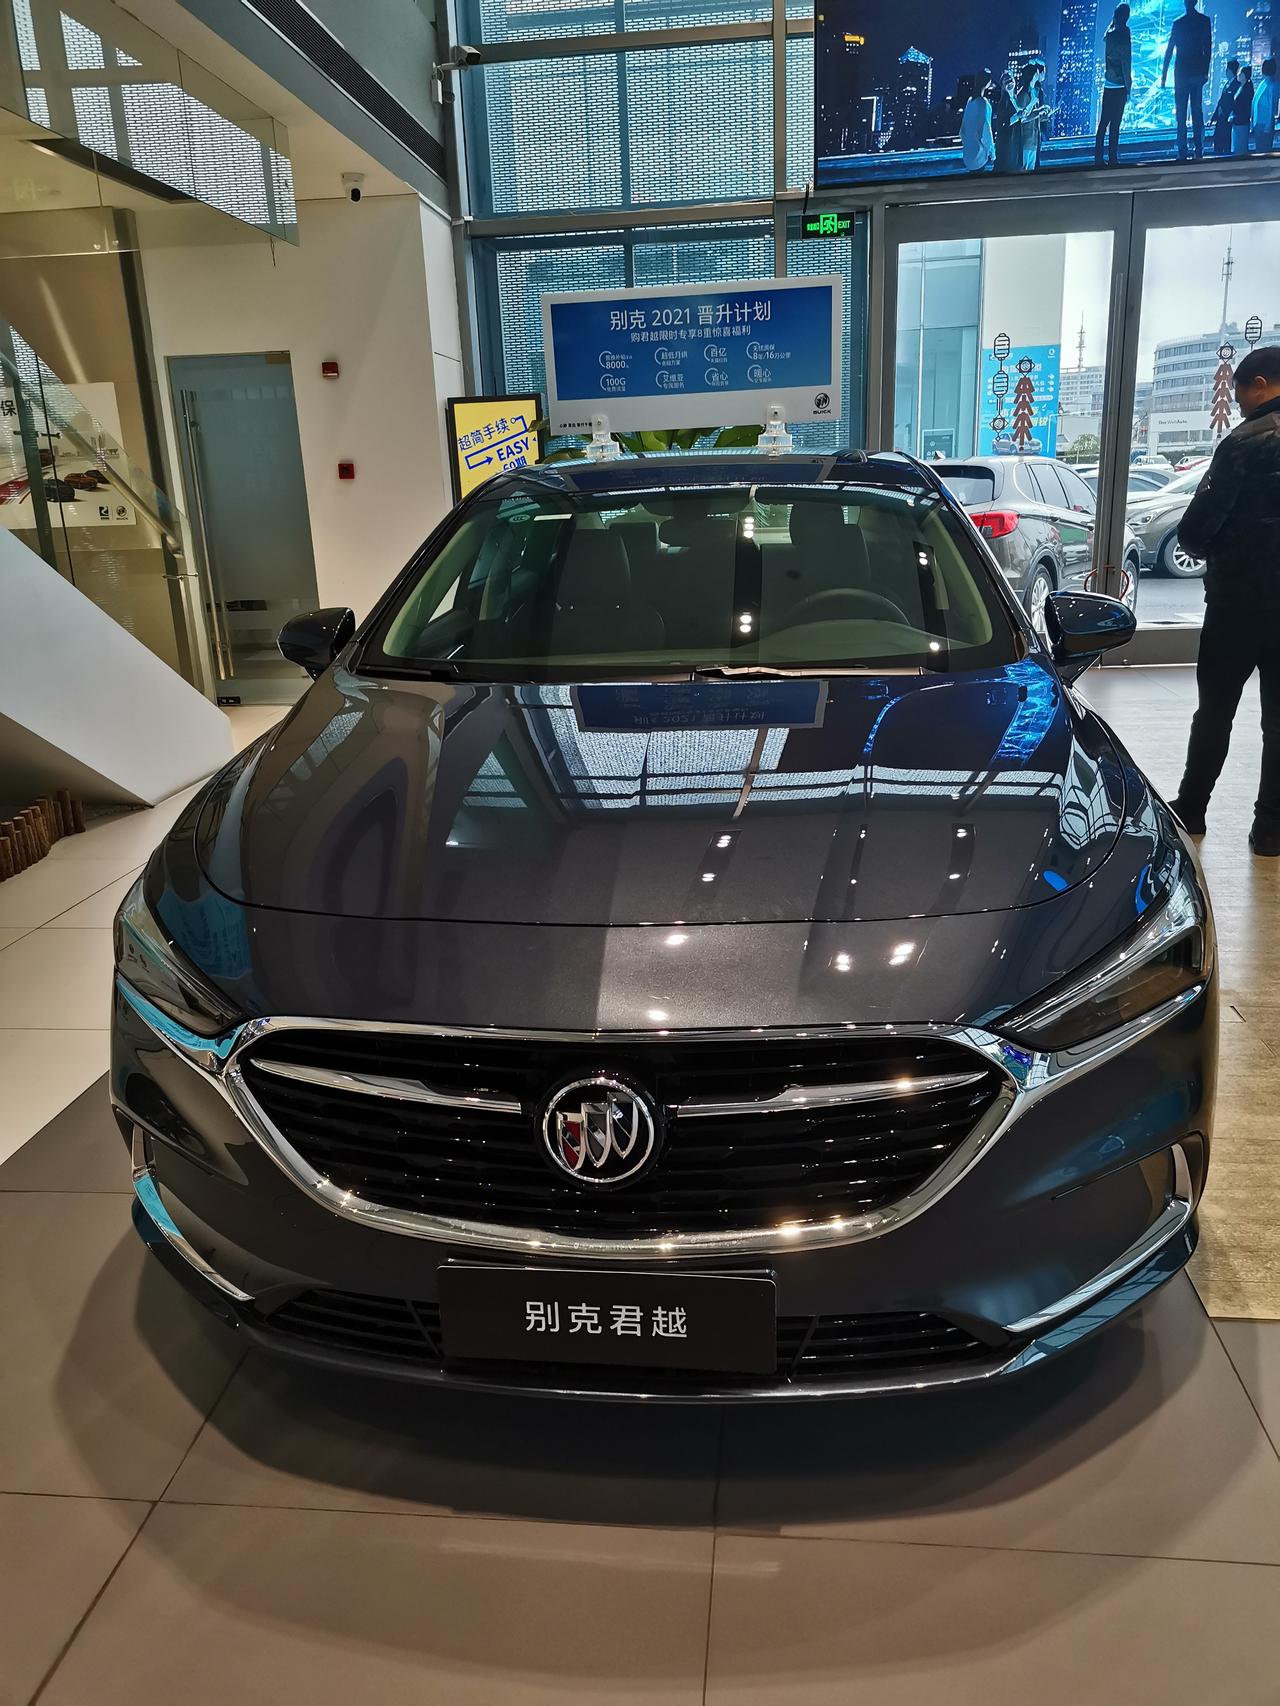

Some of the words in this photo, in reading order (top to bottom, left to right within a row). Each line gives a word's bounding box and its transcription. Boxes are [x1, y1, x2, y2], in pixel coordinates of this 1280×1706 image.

[838, 220, 850, 228] EXIT
[610, 309, 646, 331] 别克
[651, 308, 690, 326] 2021
[697, 300, 771, 325] 晋升计划
[606, 376, 626, 386] 100G
[1, 399, 17, 416] 保
[457, 417, 511, 452] 超简手续
[496, 436, 530, 462] EASY
[525, 1300, 688, 1338] 别克君越
